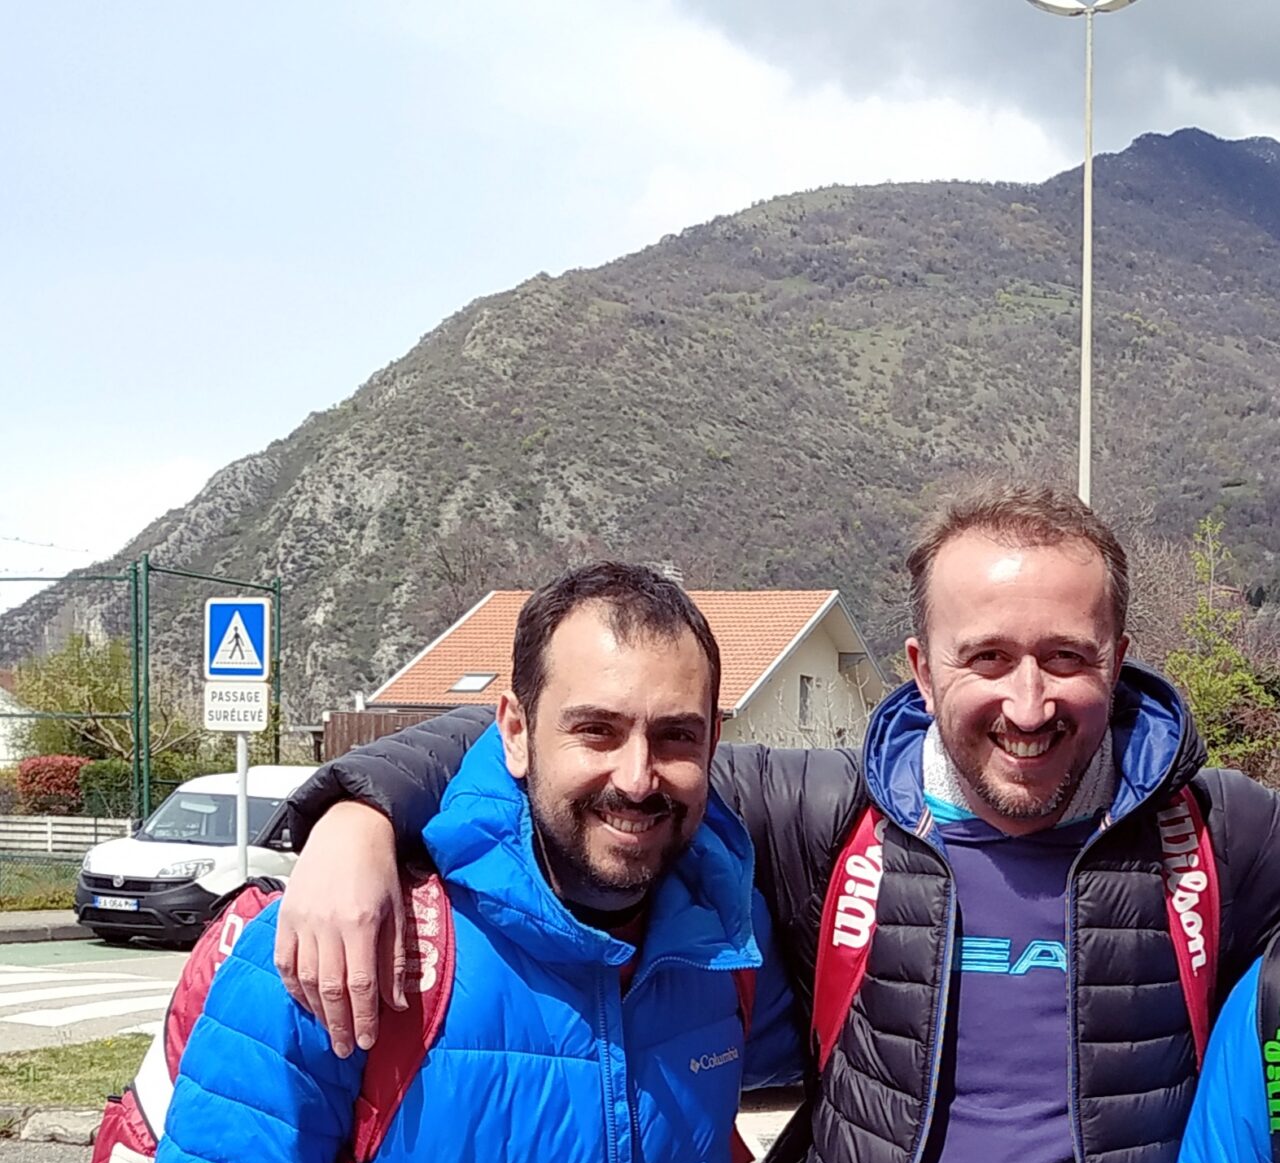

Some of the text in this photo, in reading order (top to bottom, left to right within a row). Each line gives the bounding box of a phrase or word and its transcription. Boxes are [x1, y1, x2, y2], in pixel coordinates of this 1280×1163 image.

[210, 690, 261, 702] PASSAGE
[207, 707, 264, 722] SURÉLEVÉ
[953, 936, 1067, 975] EA
